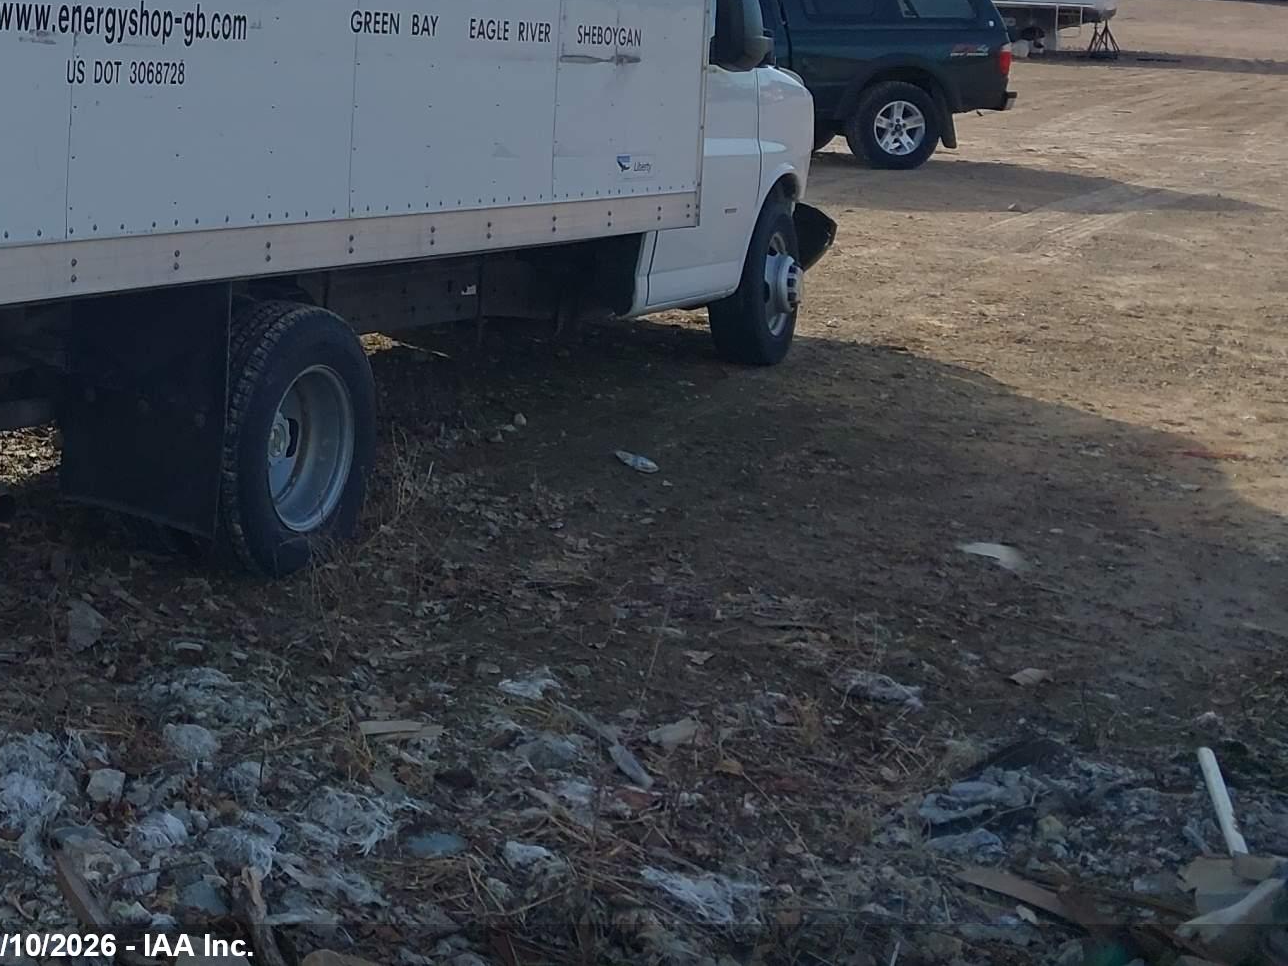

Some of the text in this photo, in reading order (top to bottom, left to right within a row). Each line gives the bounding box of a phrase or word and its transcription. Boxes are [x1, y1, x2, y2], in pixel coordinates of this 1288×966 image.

[350, 10, 642, 47] GREEN BAY EAGLE RIVER SHEBOYGAN
[66, 59, 185, 84] US DOT 3068728
